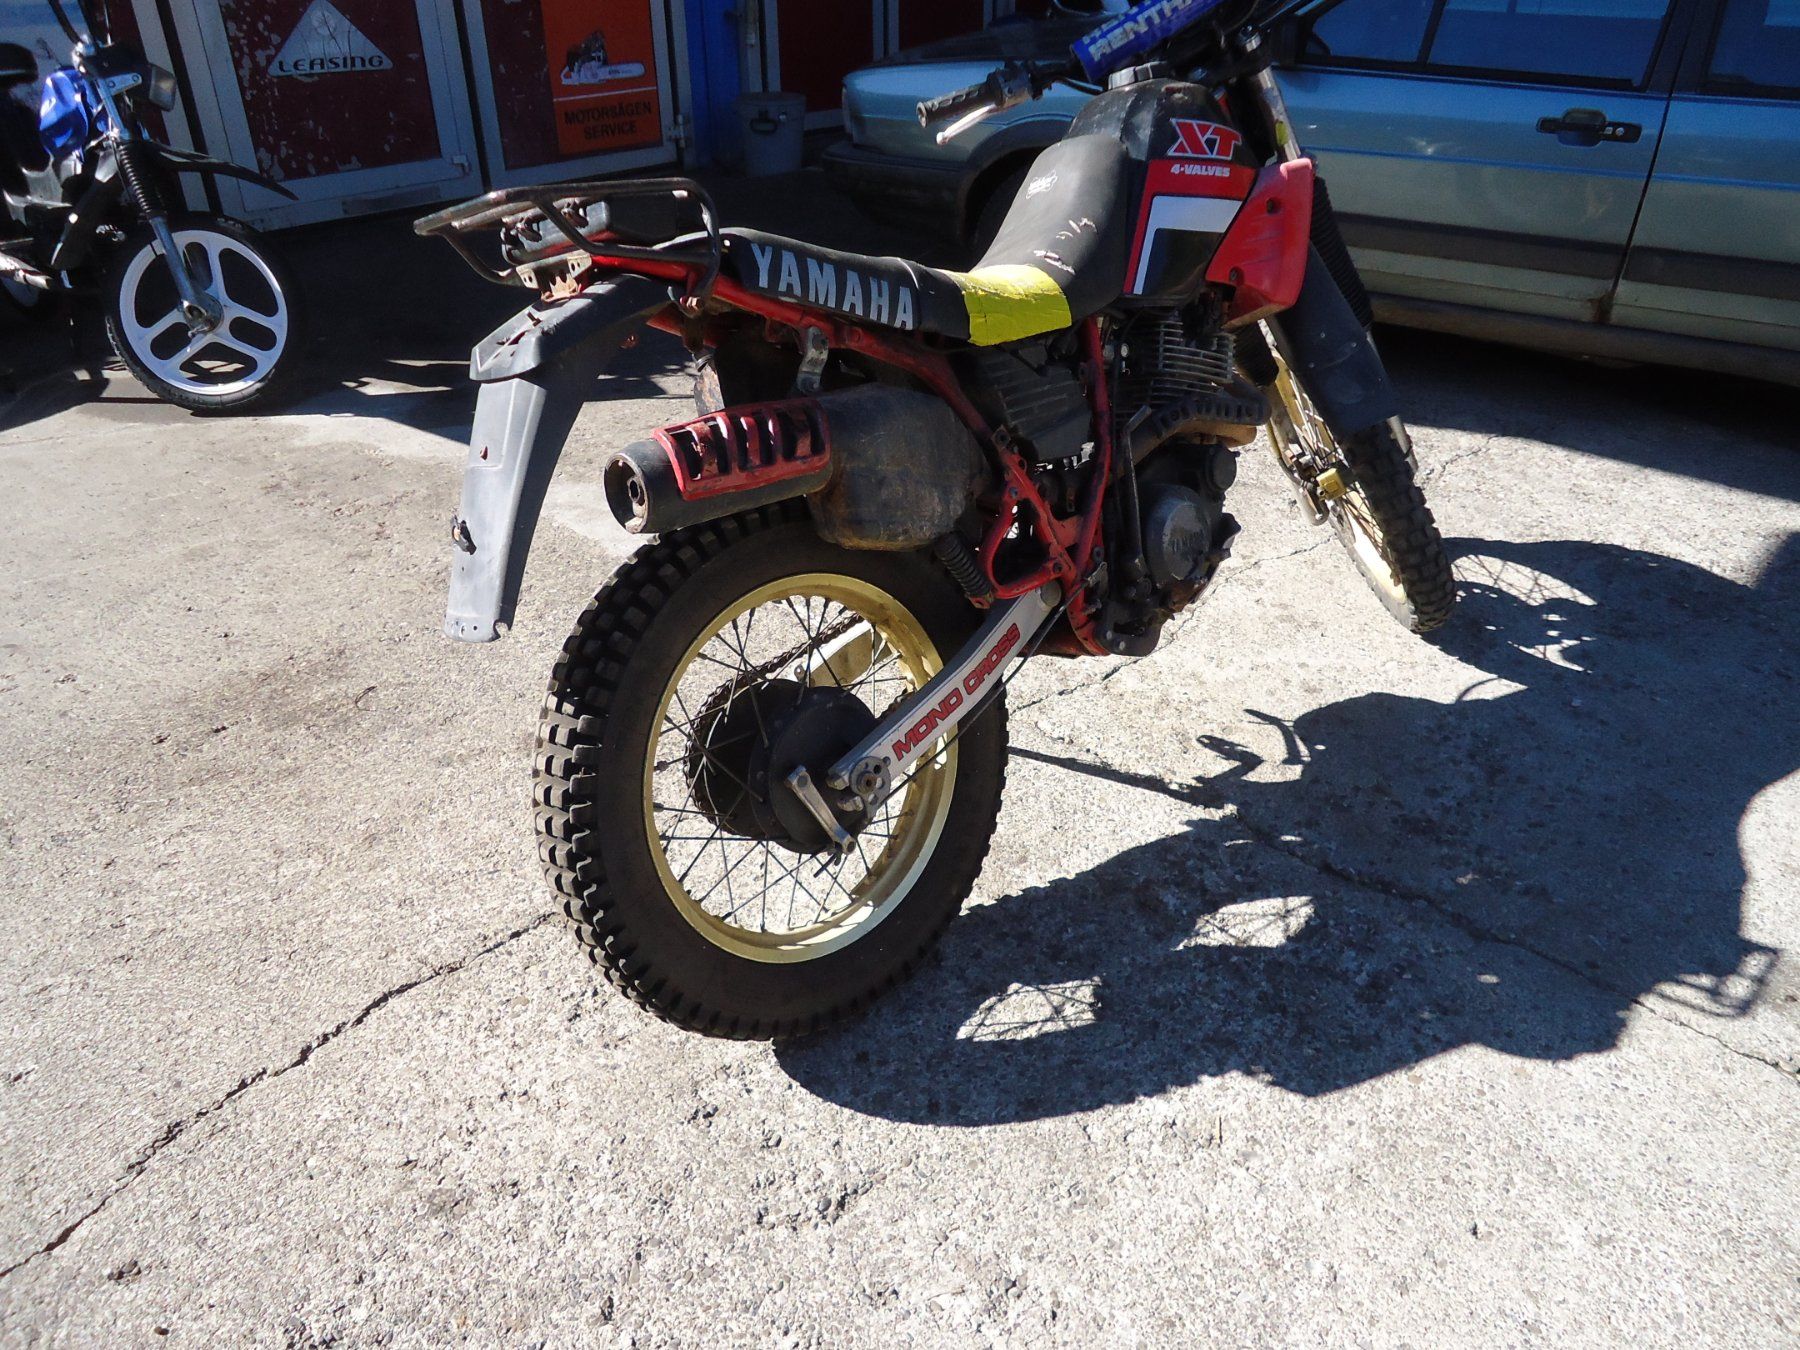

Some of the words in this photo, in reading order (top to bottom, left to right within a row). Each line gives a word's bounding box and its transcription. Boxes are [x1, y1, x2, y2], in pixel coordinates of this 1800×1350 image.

[279, 55, 384, 73] LEASING
[584, 120, 637, 140] SERVICE
[1167, 117, 1242, 160] XT
[1170, 163, 1231, 177] 4-VALVES
[750, 243, 914, 331] YAMAHA
[891, 687, 964, 761] MONO
[963, 622, 1021, 695] CROSS
